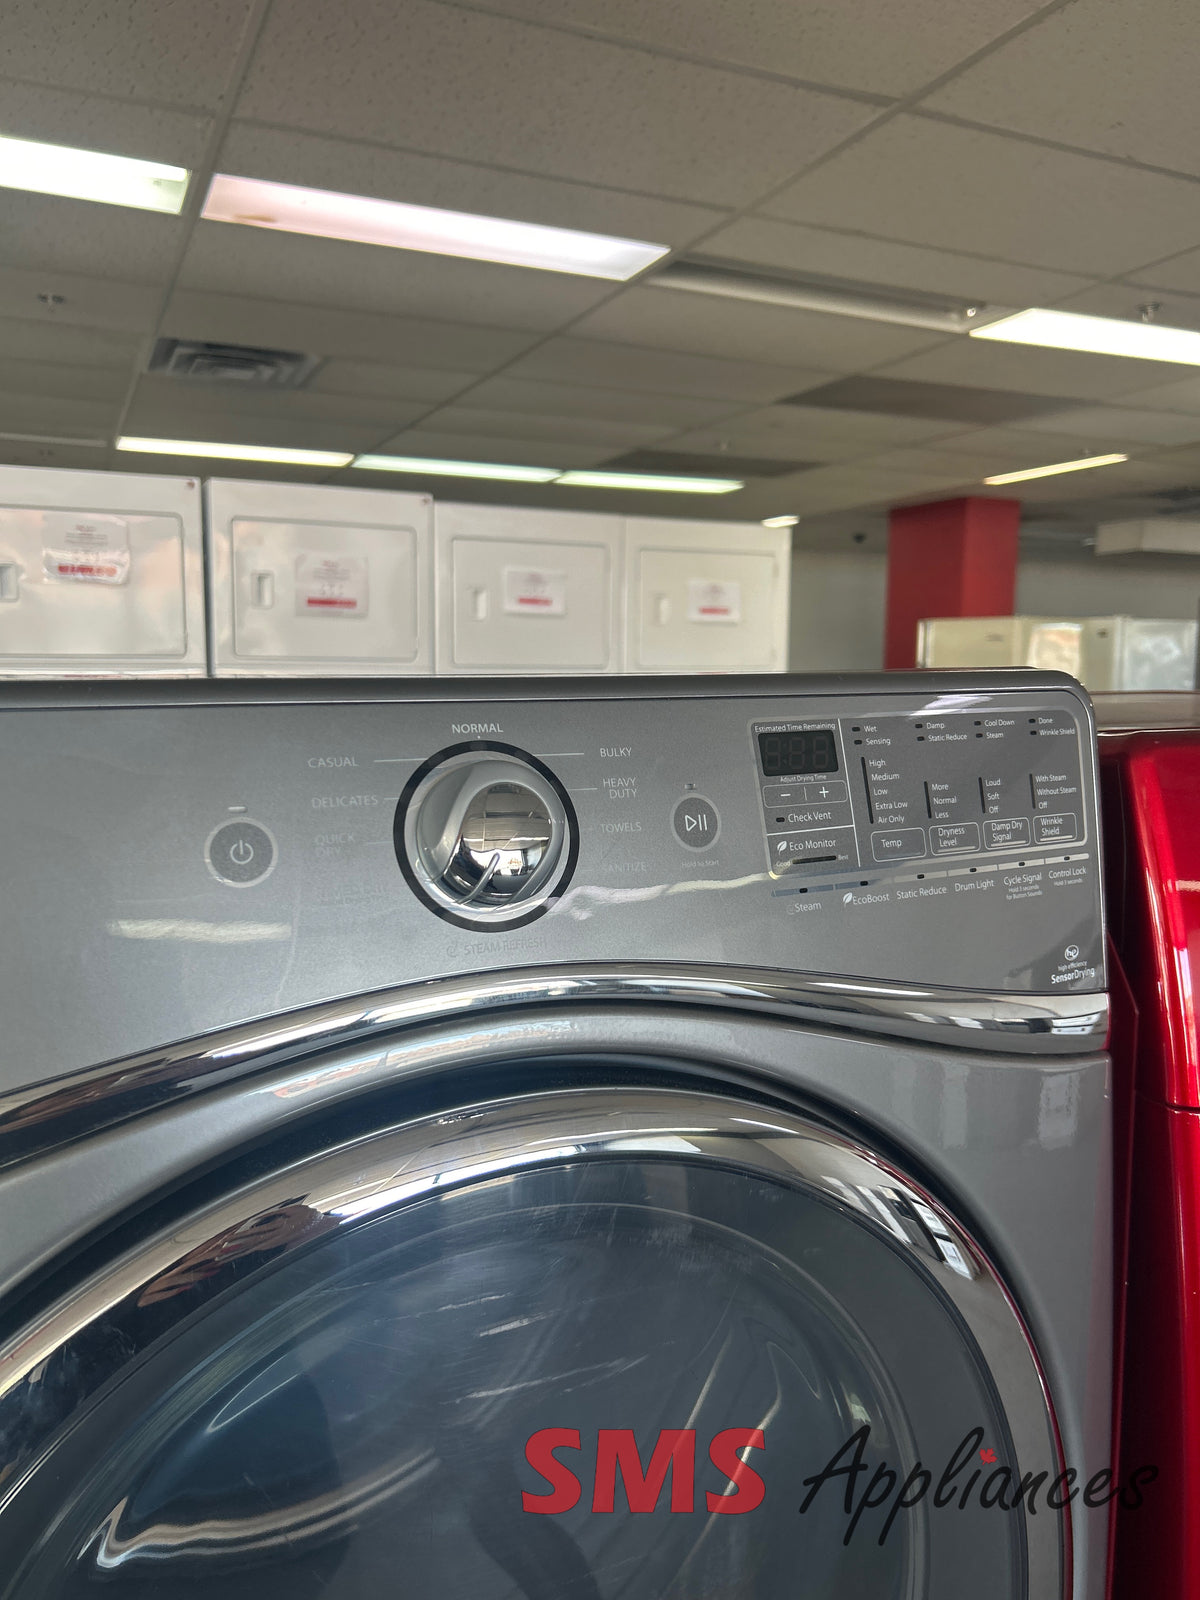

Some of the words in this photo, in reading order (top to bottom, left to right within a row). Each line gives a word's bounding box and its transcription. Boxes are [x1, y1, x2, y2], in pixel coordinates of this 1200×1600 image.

[926, 722, 945, 730] Damp
[984, 719, 998, 727] Cool
[1038, 717, 1053, 725] Done
[451, 724, 504, 734] NORMAL
[754, 723, 787, 733] Estimated
[787, 722, 803, 731] Time
[803, 722, 836, 730] Remaining
[864, 725, 877, 733] Wet
[1039, 728, 1059, 736] Wrinkle
[928, 734, 945, 742] Static
[945, 733, 968, 741] Reduce
[986, 731, 1004, 739] Steam
[866, 738, 891, 746] Sensing
[599, 747, 632, 758] BULKY
[307, 757, 359, 768] CASUAL
[869, 759, 886, 769] High
[871, 773, 900, 781] Medium
[1035, 774, 1049, 783] With
[602, 777, 636, 788] HEAVY
[931, 783, 949, 791] More
[985, 778, 1001, 787] Loud
[609, 789, 638, 799] DUTY
[1036, 787, 1059, 796] Without
[1059, 786, 1077, 794] Steam
[311, 794, 378, 809] DELICATES
[933, 796, 957, 805] Normal
[987, 793, 1000, 801] Soft
[875, 803, 893, 811] Extra
[893, 801, 908, 809] Low
[988, 806, 999, 814] Off
[1038, 801, 1048, 809] Off
[788, 812, 812, 823] Check
[812, 811, 832, 821] Vent
[878, 815, 888, 824] Air
[888, 814, 905, 824] Only
[1040, 816, 1063, 826] Wrinkle
[600, 821, 642, 833] TOWELS
[991, 823, 1011, 832] Damp
[1011, 820, 1023, 831] Dry
[938, 827, 966, 838] Dryness
[1041, 826, 1060, 837] Shield
[939, 837, 958, 847] Level
[992, 831, 1012, 843] Signal
[789, 841, 804, 851] Eco
[805, 839, 836, 849] Monitor
[881, 839, 903, 849] Temp
[1048, 869, 1073, 880] Control
[1071, 866, 1088, 876] Lock
[1003, 875, 1023, 887] Cycle
[1022, 872, 1043, 885] Signal
[954, 882, 975, 893] Drum
[975, 878, 995, 892] Light
[896, 888, 919, 900] Static
[919, 885, 948, 897] Reduce
[852, 893, 890, 906] EcoBoost
[794, 901, 822, 913] Steam
[1051, 967, 1095, 984] SensorDrying
